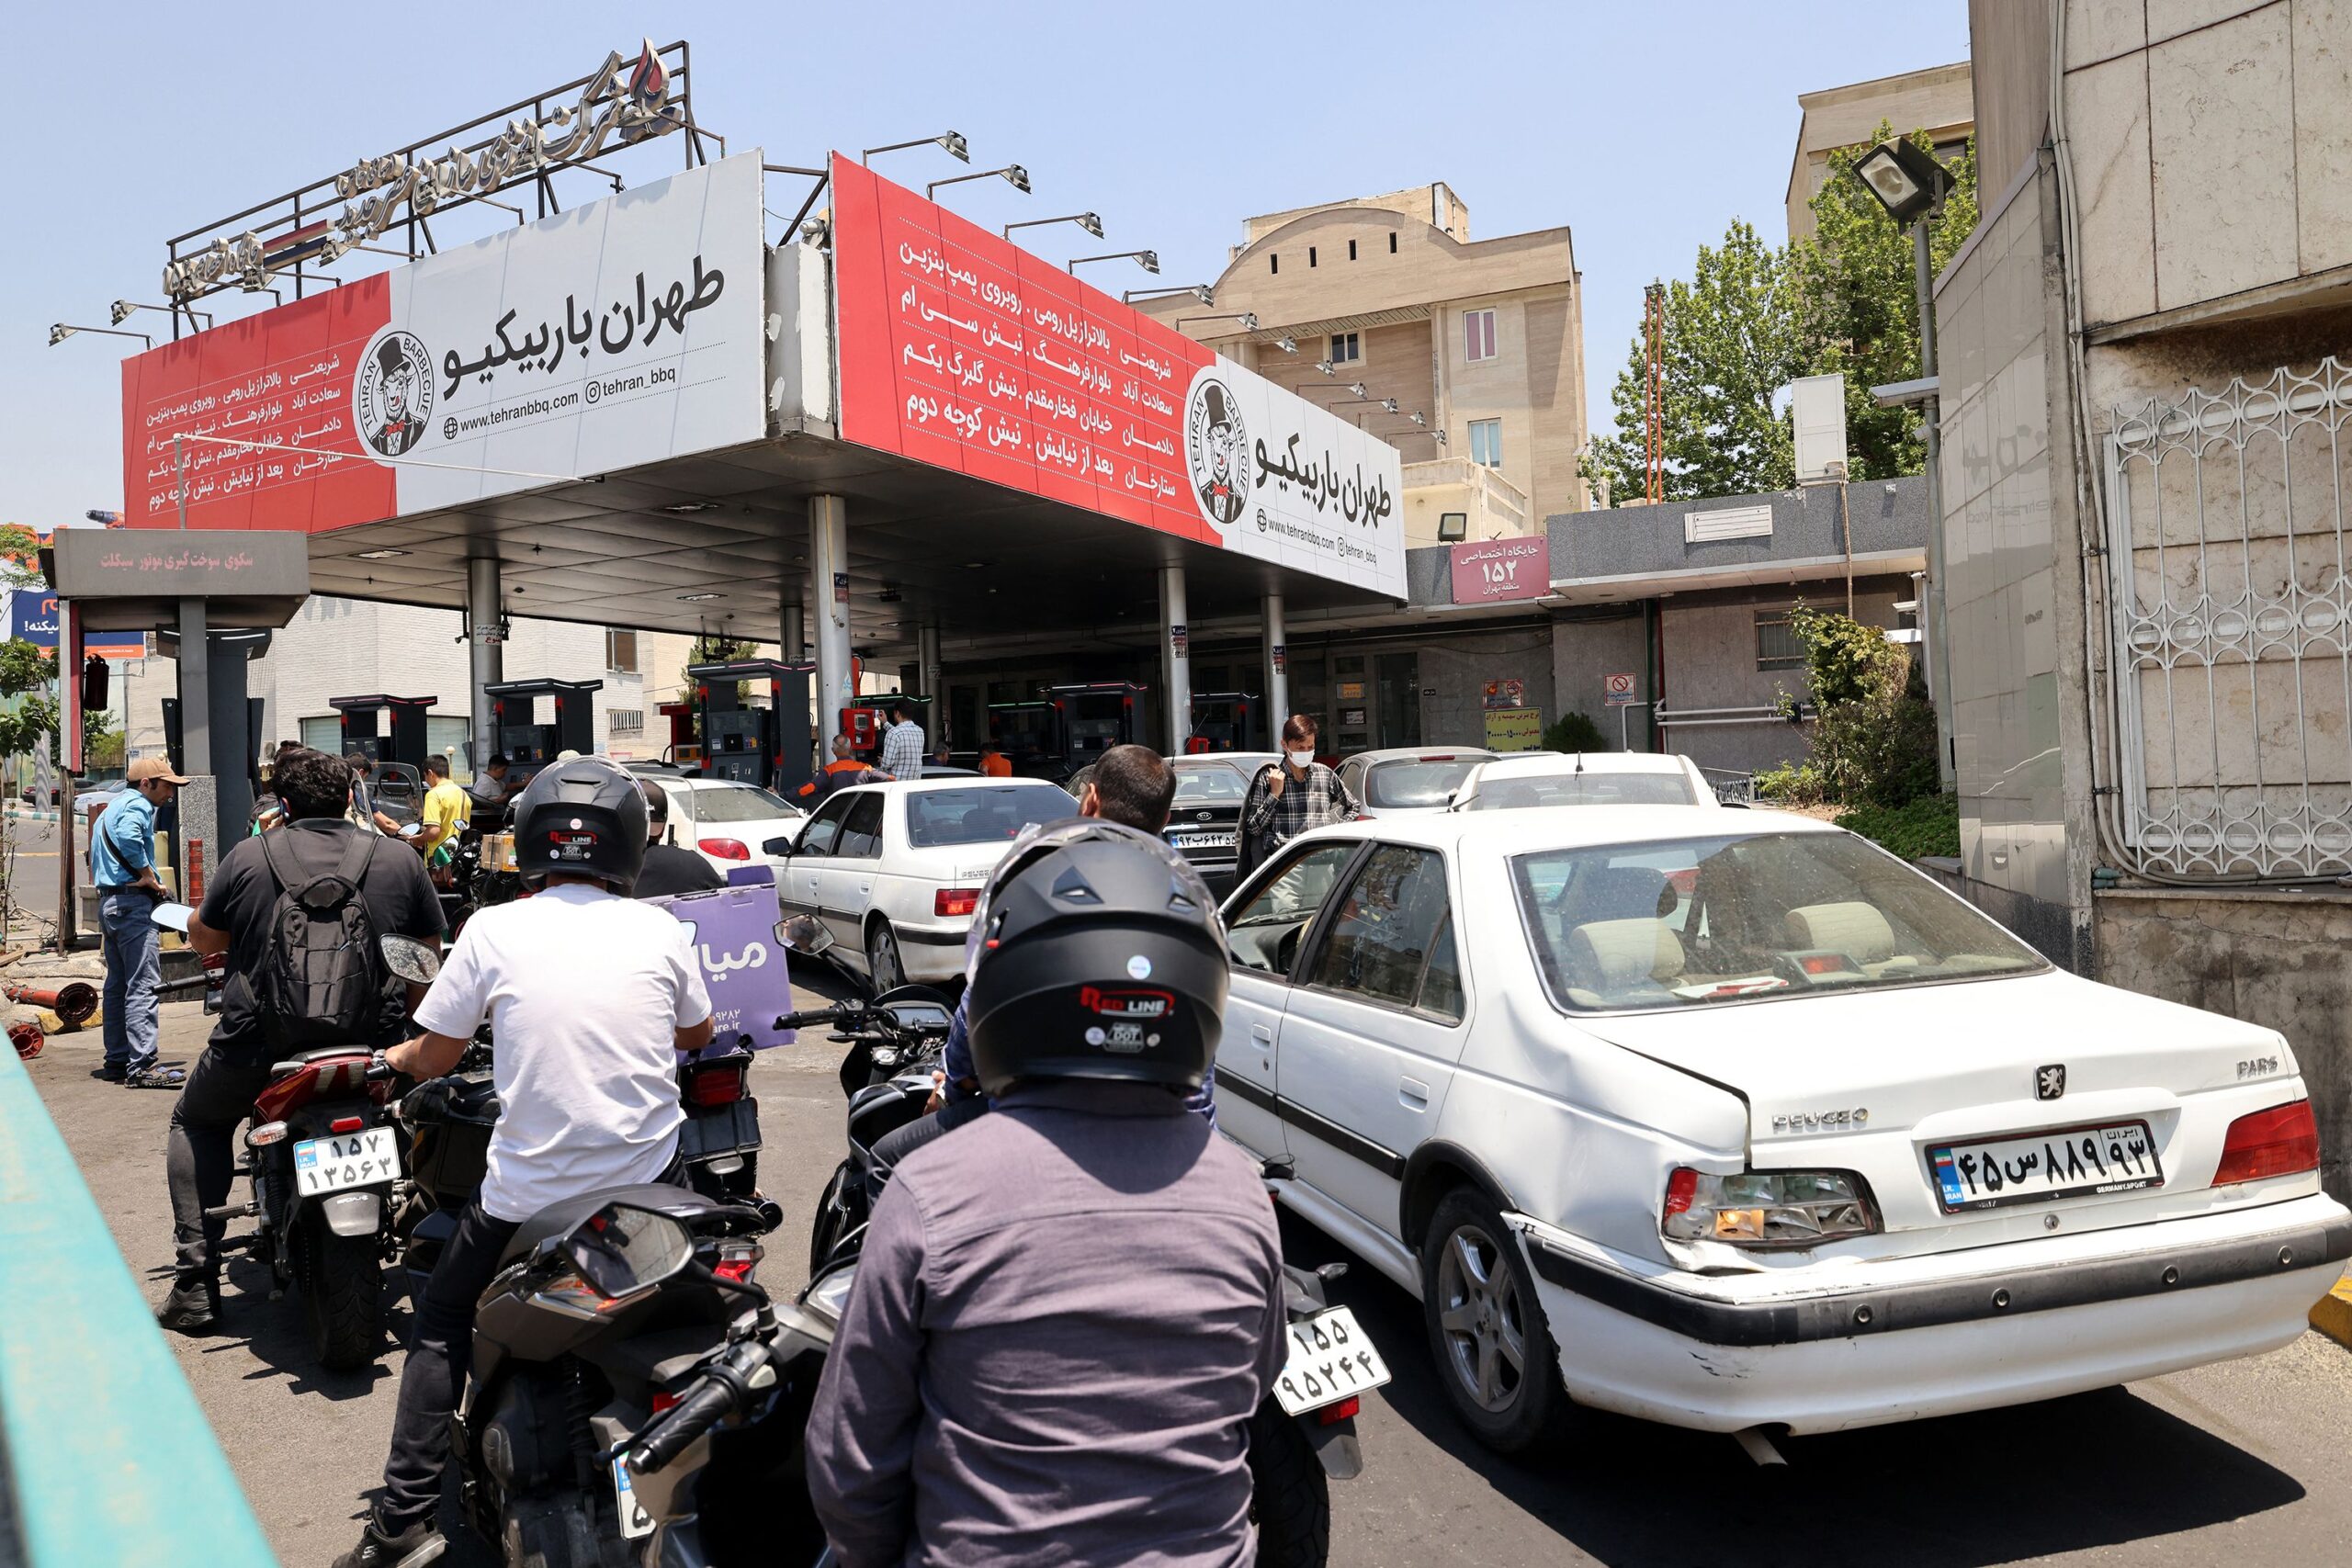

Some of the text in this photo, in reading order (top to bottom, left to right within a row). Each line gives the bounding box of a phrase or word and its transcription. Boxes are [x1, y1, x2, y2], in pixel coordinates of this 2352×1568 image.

[899, 242, 944, 278] بنزین
[945, 262, 978, 296] پمپ
[980, 282, 1022, 315] روبروی
[443, 254, 724, 401] طهران باربیکیو
[1034, 307, 1062, 333] رومی
[901, 285, 1173, 416] سعادت آباد بلوار فرهنگ نبش سی ام
[903, 343, 944, 375] یکم
[289, 353, 340, 385] شریعتی
[946, 351, 985, 386] گلبرگ
[1119, 347, 1172, 381] شریعتی
[361, 337, 432, 431] TEHRAN BARBECUE
[603, 367, 676, 397] tehran_bbq
[989, 371, 1018, 401] نبش
[189, 396, 216, 414] روبروی
[222, 388, 243, 404] رومی
[292, 391, 307, 411] آباد
[309, 387, 341, 404] سعادت
[146, 407, 170, 427] بنزین
[170, 403, 188, 420] پمپ
[460, 391, 579, 433] www.tehranbbq.com
[1080, 406, 1114, 434] خیابان
[255, 432, 283, 455] خیابان
[291, 416, 342, 446] دادمان
[1122, 423, 1174, 456] دادمان
[907, 394, 1176, 499] ستارخان بعد از نیایش نبش کوچه دوم
[1192, 396, 1248, 495] TEHRAN BARBECUE
[147, 460, 169, 483] یکم
[170, 451, 192, 472] گلبگ
[193, 450, 212, 470] نبش
[266, 464, 284, 479] بعد
[293, 450, 343, 476] ستارخان
[223, 467, 254, 493] نیایش
[255, 463, 264, 486] از
[1255, 433, 1392, 529] طهران باربیکیو
[193, 477, 215, 500] نبش
[149, 491, 166, 512] دوم
[1268, 517, 1335, 551] www.tehranbbq.com
[100, 550, 254, 571] سکوی سوخت گیری موتور سیکلت
[1345, 543, 1377, 567] tehran_bbq
[1460, 545, 1539, 565] جایگاه اختصاصی
[1482, 559, 1517, 583] ۱۵۲
[1483, 584, 1501, 595] تهران
[1127, 999, 1166, 1013] LINE
[1113, 1030, 1140, 1042] DOT
[2236, 1056, 2278, 1078] PARS
[1771, 1107, 1869, 1132] PEUGEO
[332, 1134, 379, 1158] ۱۵۷
[2106, 1128, 2139, 1140] ایران
[300, 1160, 317, 1168] IRAN
[2109, 1139, 2146, 1176] ۹۳
[307, 1156, 391, 1189] ۱۳۵۶۳
[1945, 1191, 1962, 1201] IRAN
[1293, 1317, 1349, 1356] ۱۵۵
[1281, 1349, 1375, 1402] ۹۵۲۴۴
